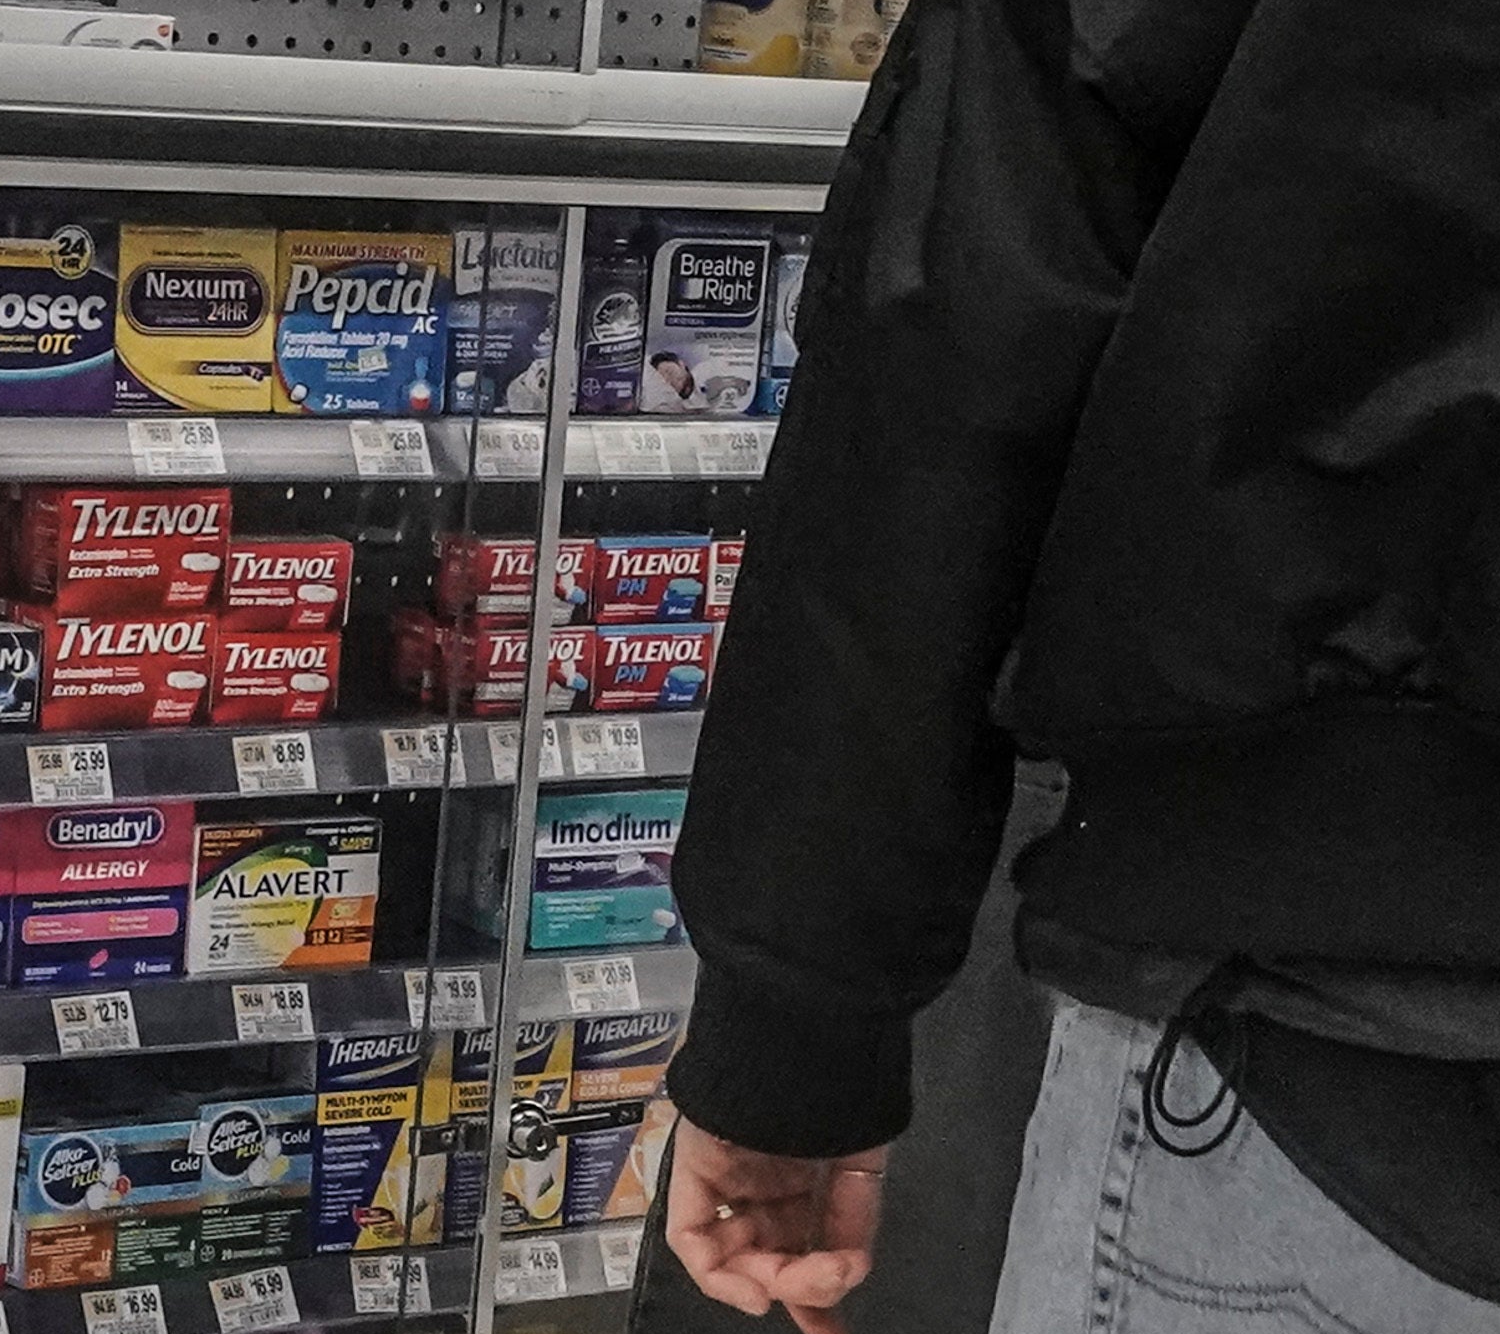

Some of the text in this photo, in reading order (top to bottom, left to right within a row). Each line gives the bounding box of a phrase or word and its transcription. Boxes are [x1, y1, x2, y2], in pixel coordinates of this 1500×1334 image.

[58, 236, 87, 257] 24
[356, 244, 427, 261] STRENGTH
[680, 253, 755, 279] Breathe
[145, 272, 247, 300] Nexium
[284, 264, 432, 328] Pepcid
[704, 275, 755, 304] Right
[207, 301, 249, 323] 24HR
[411, 315, 437, 334] AC
[37, 333, 77, 356] OTC
[322, 394, 342, 411] 25
[71, 498, 221, 543] TYLENOL
[68, 563, 160, 579] Extra Strength
[231, 553, 338, 583] TYLENOL
[606, 548, 702, 578] TYLENOL
[617, 578, 648, 596] PM
[56, 617, 207, 661] TYLENOL
[224, 643, 329, 673] TYLENOL
[605, 636, 703, 666] TYLENOL
[614, 666, 648, 684] PM
[52, 681, 145, 698] Extra Strength
[70, 750, 105, 772] $25.99
[272, 742, 306, 764] $8.89
[58, 815, 152, 847] Benadryl
[550, 813, 671, 845] Imodium
[60, 859, 150, 881] ALLERGY
[213, 870, 348, 900] ALAVERT
[93, 1000, 129, 1023] $12.79
[584, 1012, 670, 1045] THERAFLU
[329, 1032, 421, 1067] THERAFLU
[215, 1120, 252, 1137] Alka-
[282, 1131, 311, 1146] Cold
[208, 1130, 259, 1156] Seltzer
[50, 1148, 88, 1166] Alka-
[171, 1156, 200, 1173] Cold
[43, 1160, 97, 1183] Seltzer
[71, 1169, 101, 1188] PLUS
